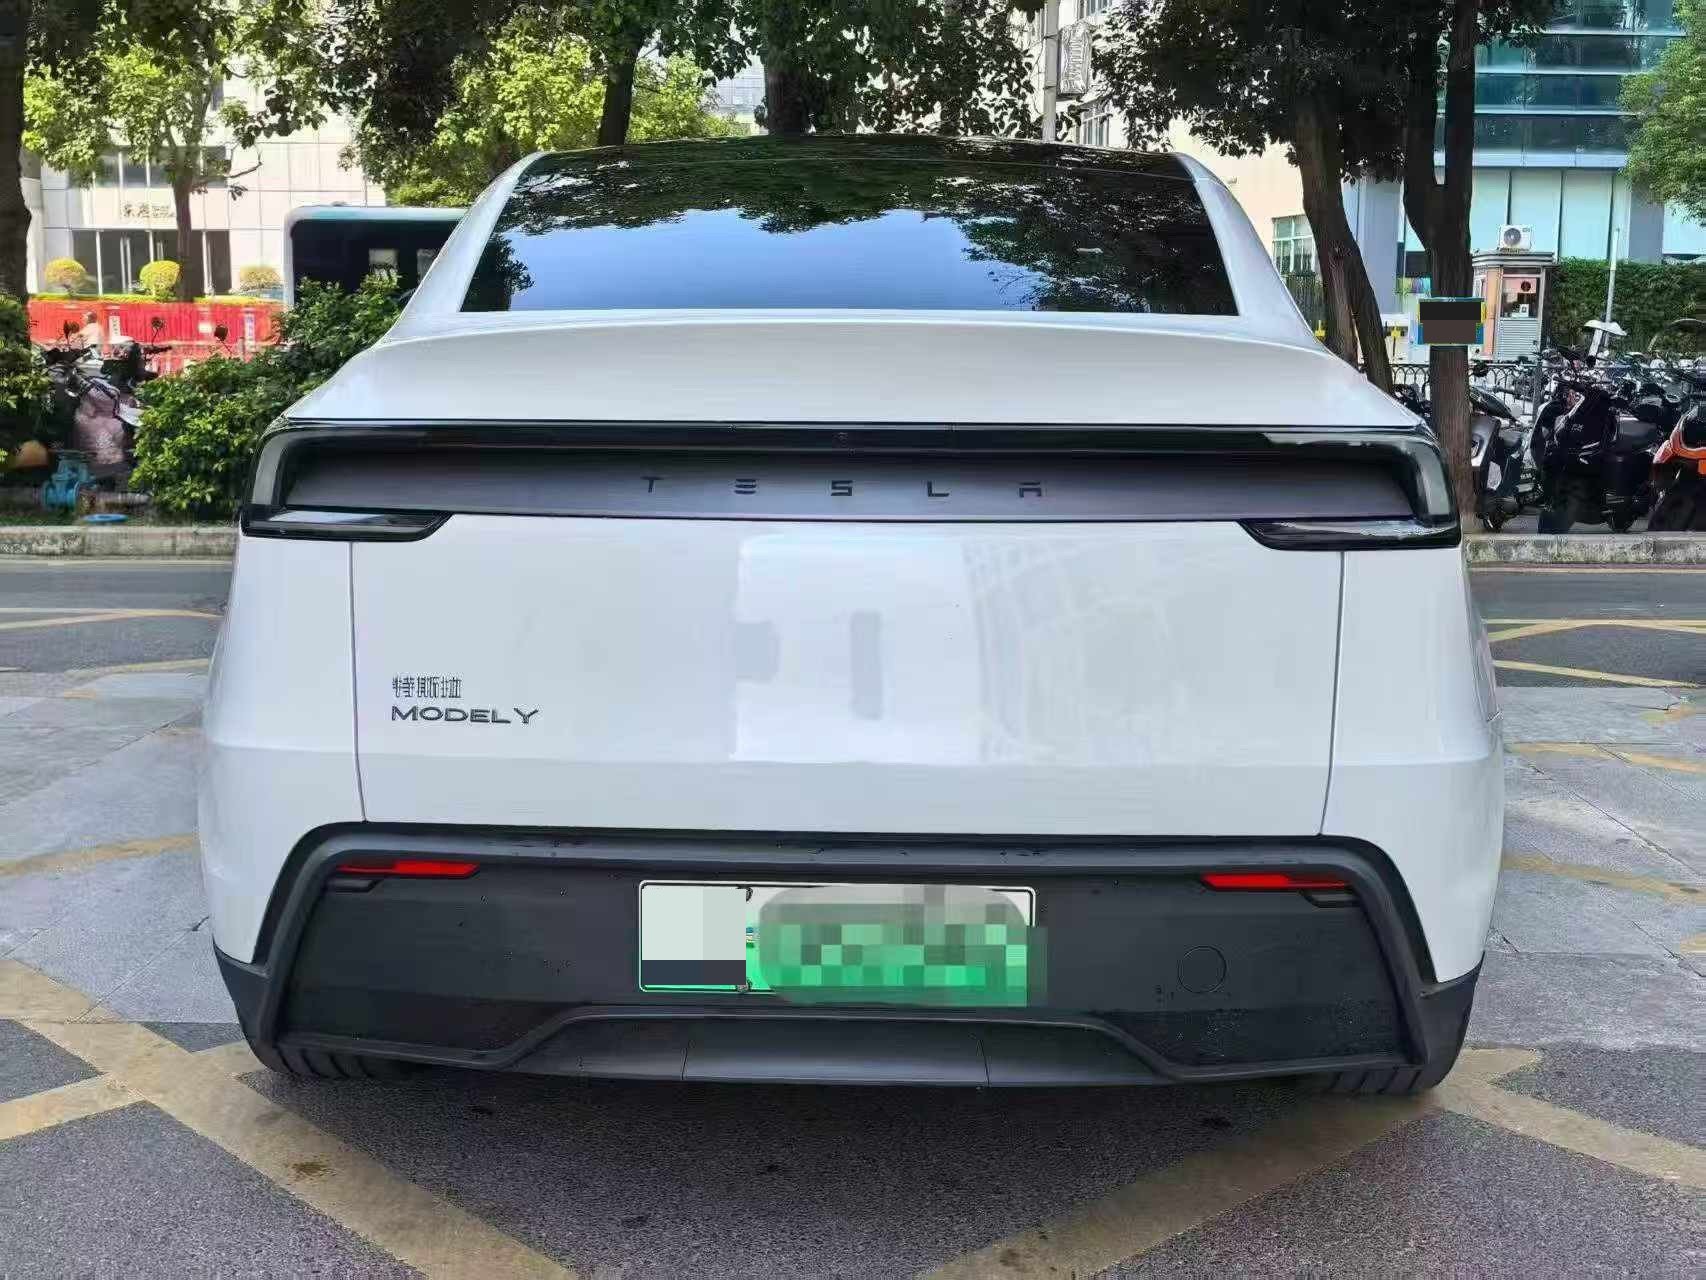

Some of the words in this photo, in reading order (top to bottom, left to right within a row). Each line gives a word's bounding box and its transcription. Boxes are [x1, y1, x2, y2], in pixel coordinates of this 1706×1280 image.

[640, 475, 1043, 498] TESLA
[391, 676, 462, 699] 特斯拉
